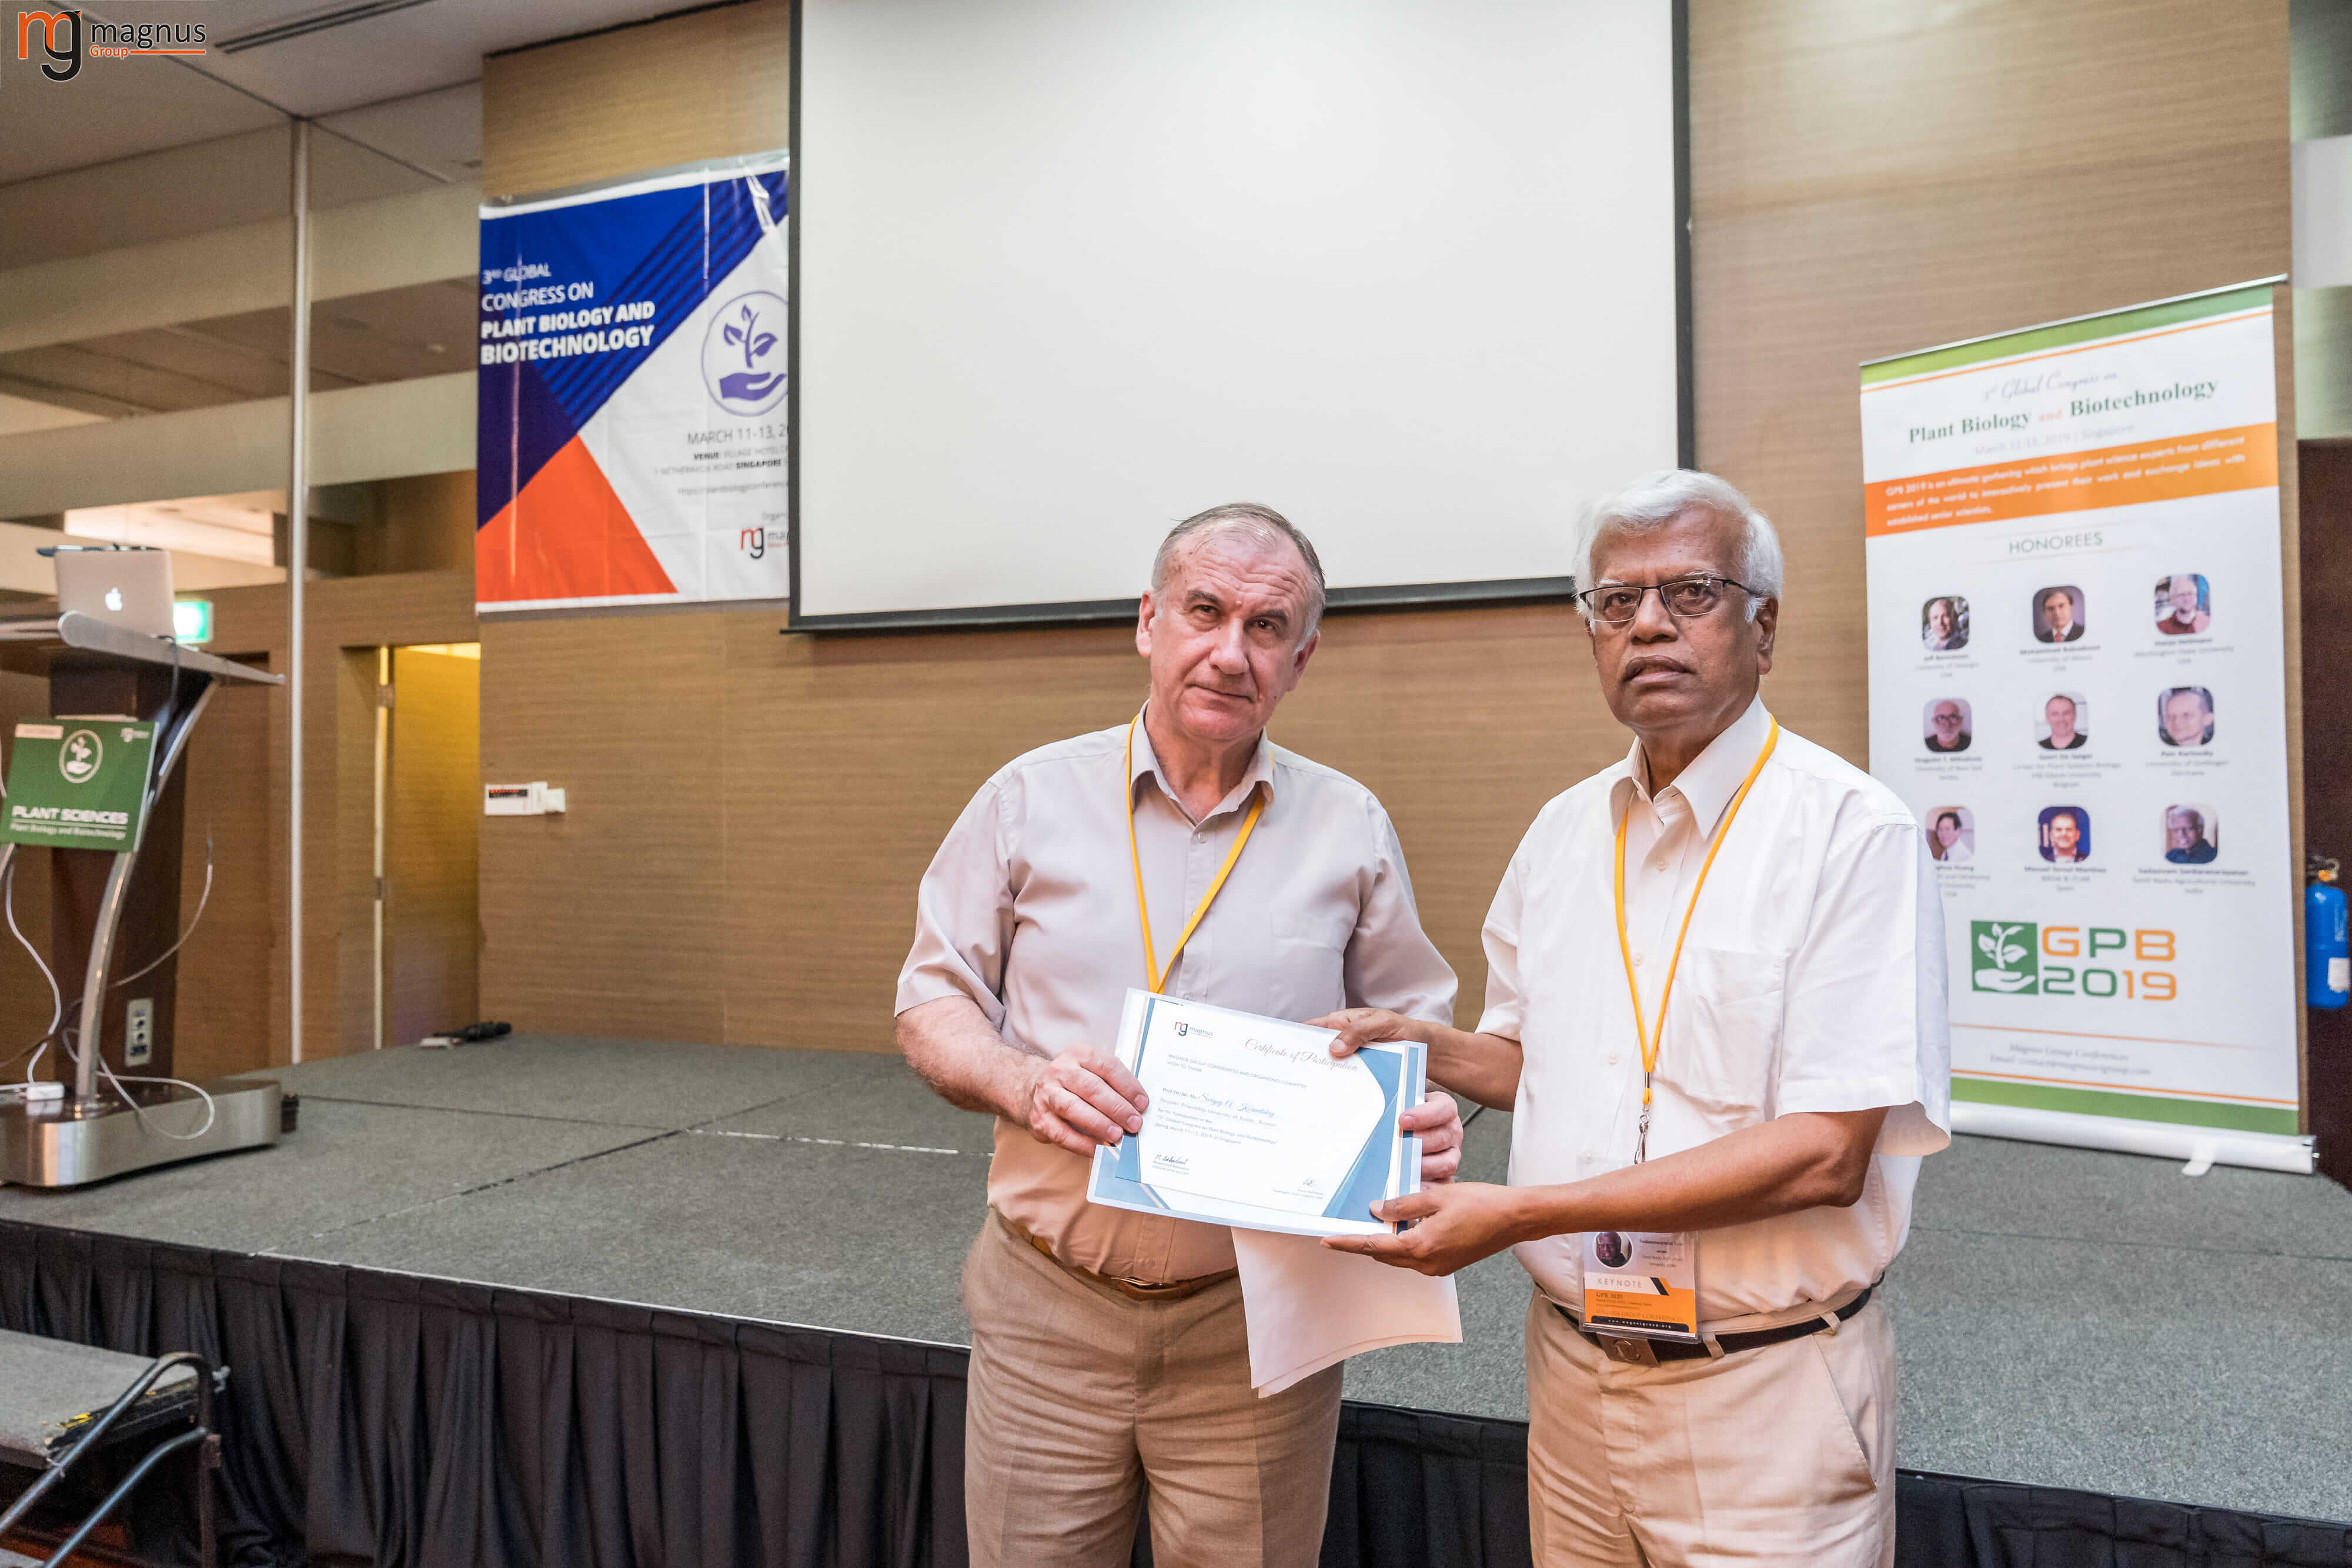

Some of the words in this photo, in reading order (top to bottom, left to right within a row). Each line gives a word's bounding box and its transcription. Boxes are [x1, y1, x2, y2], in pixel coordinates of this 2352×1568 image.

[503, 262, 552, 282] GLOBAL
[482, 285, 565, 312] CONGRESS
[568, 281, 593, 301] ON
[480, 316, 537, 339] PLANT
[539, 306, 614, 333] BIOLOGY
[615, 301, 655, 323] AND
[480, 325, 654, 365] BIOTECHNOLOGY
[1910, 423, 1953, 443] Plant
[1962, 412, 2030, 434] Biology
[2038, 409, 2063, 422] and
[2070, 380, 2217, 417] Biotechnology
[687, 428, 733, 445] MARCH
[736, 459, 781, 470] SINGAPORE
[1905, 482, 1926, 494] 2019
[2177, 444, 2199, 453] from
[2008, 531, 2103, 554] HONOREES
[12, 805, 60, 819] PLANT
[2042, 926, 2176, 962] GPB
[2042, 966, 2177, 1001] 2019
[1190, 1027, 1213, 1037] magnus
[1245, 1039, 1287, 1058] Certificate
[1290, 1052, 1300, 1062] of
[1301, 1051, 1358, 1071] Participation
[1598, 1278, 1642, 1289] KEYNOTE
